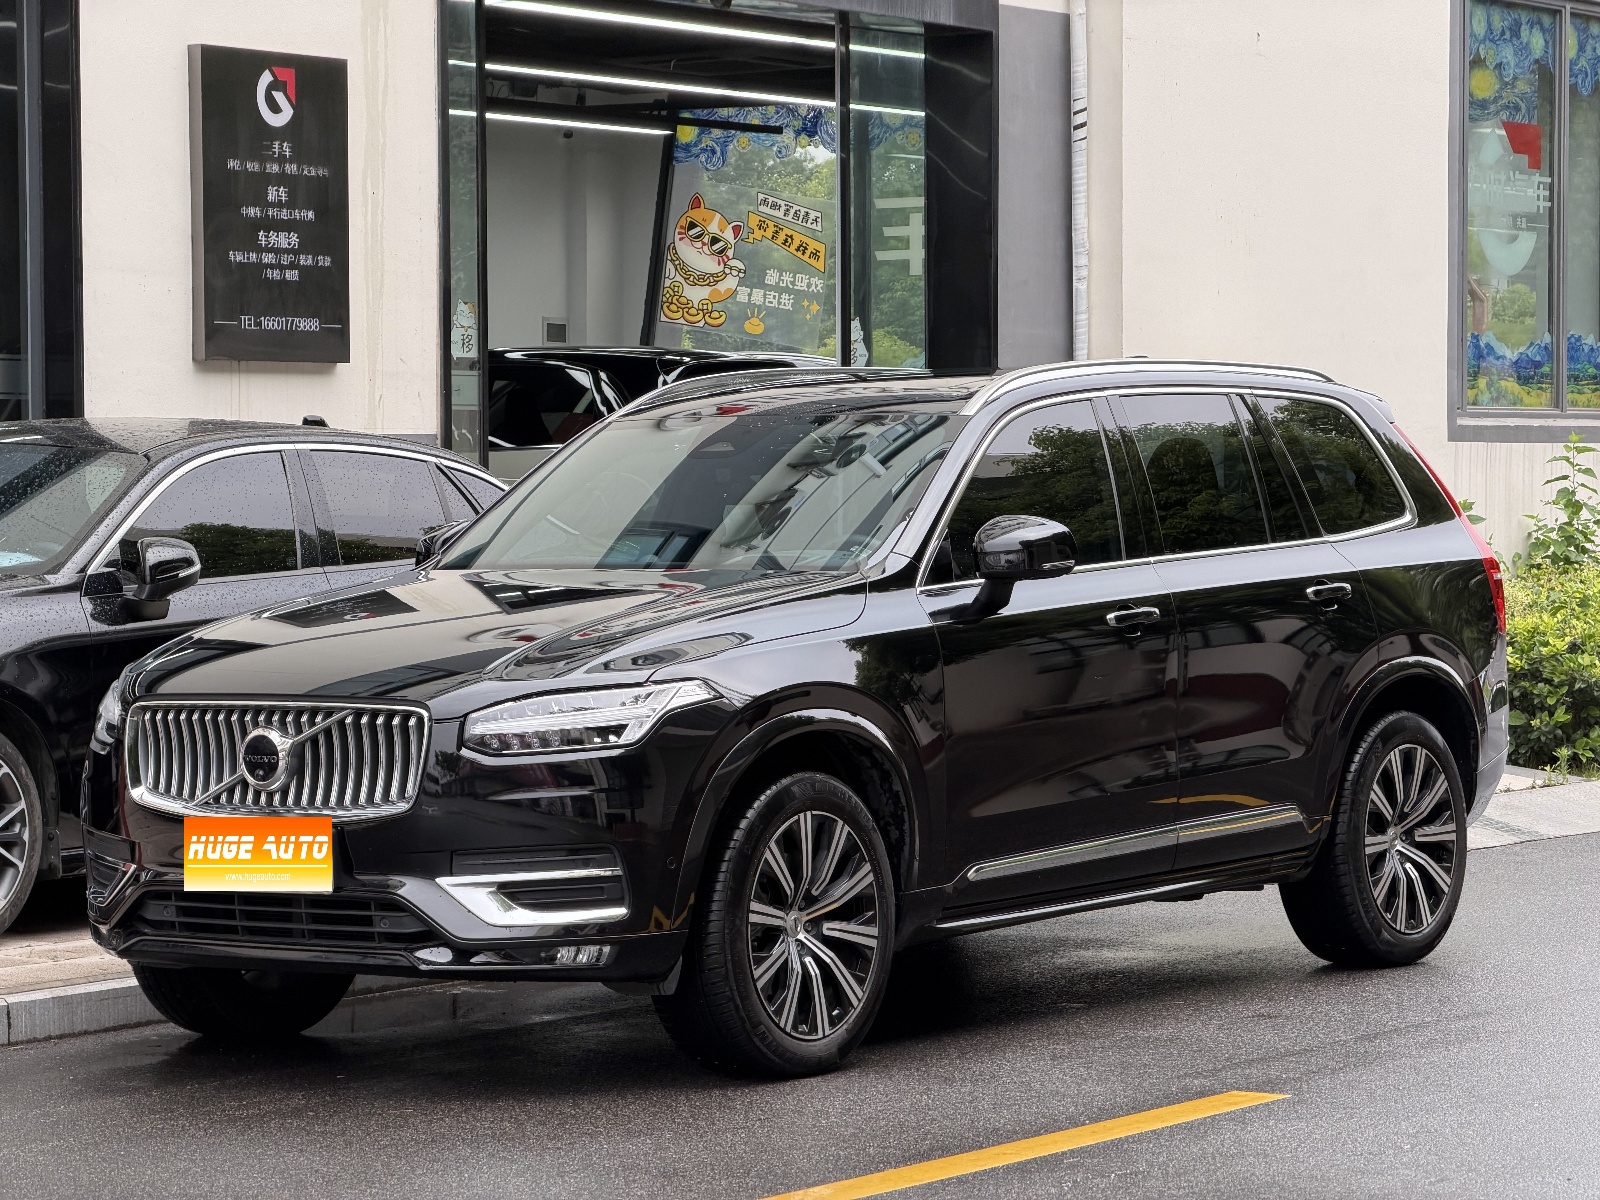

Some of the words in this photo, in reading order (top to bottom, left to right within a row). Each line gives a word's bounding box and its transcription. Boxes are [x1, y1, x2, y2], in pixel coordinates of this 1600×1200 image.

[262, 141, 293, 158] 二手车
[267, 185, 288, 203] 新车
[257, 230, 299, 248] 车务服务
[239, 316, 320, 331] TEL:16601779888
[244, 754, 278, 763] VOLVO
